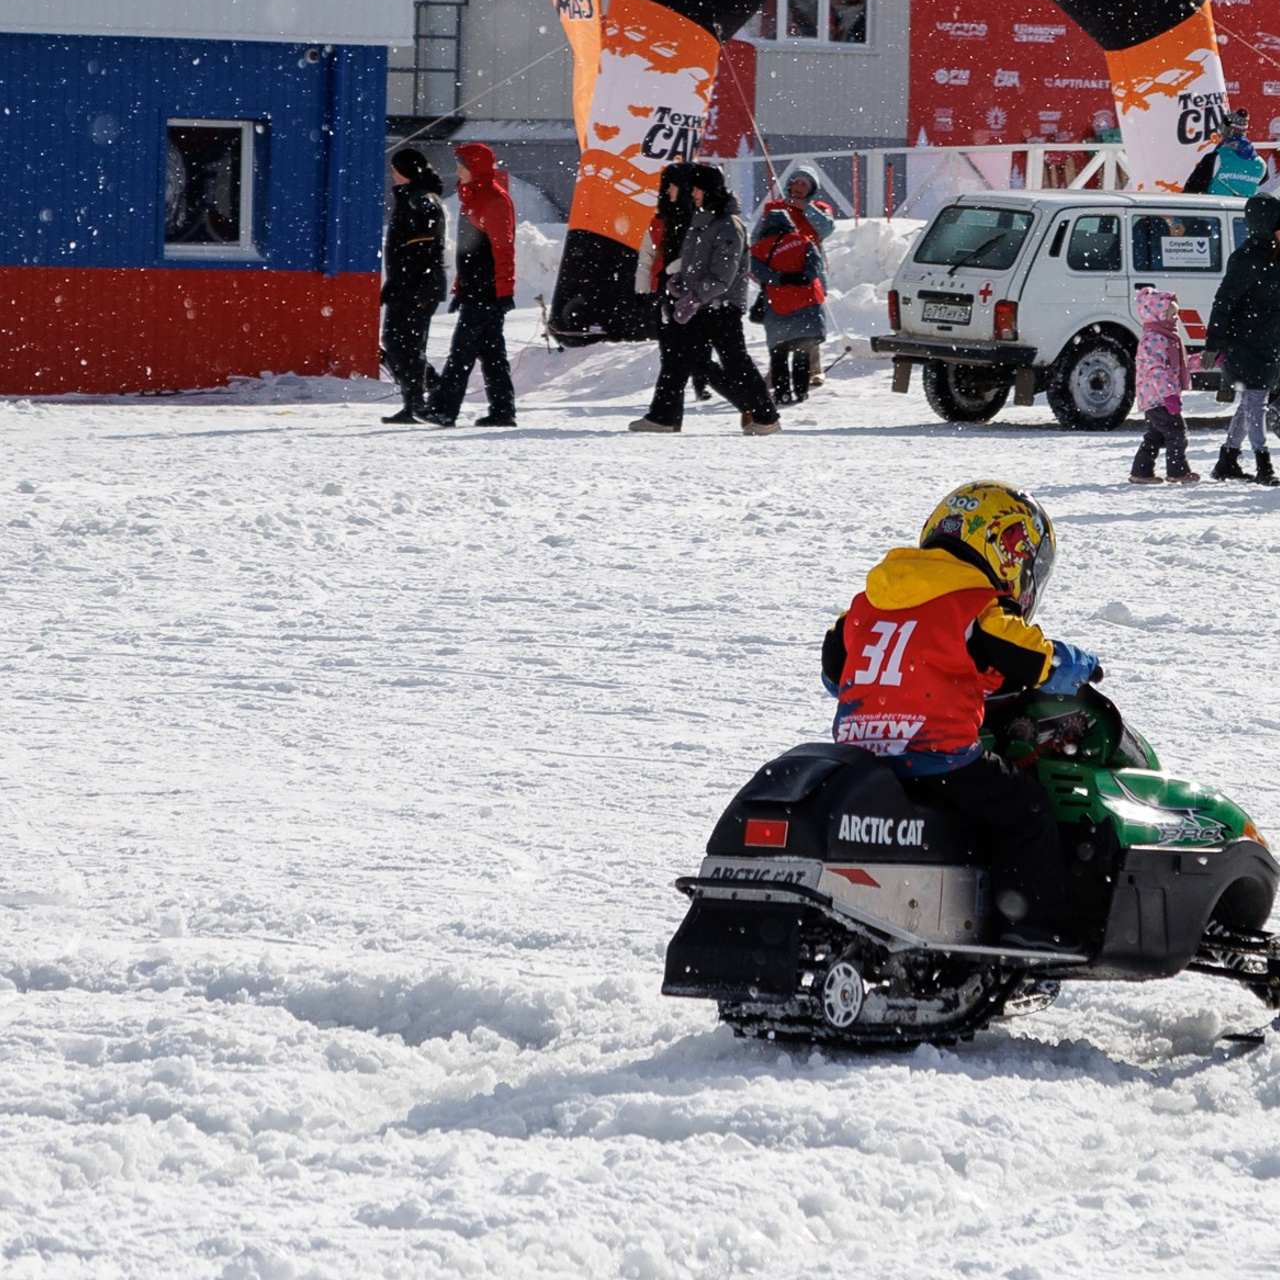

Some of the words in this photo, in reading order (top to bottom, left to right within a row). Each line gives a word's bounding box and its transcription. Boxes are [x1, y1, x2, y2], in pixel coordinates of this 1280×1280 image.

[854, 620, 918, 687] 31
[882, 713, 927, 722] ФЕСТИВАЛЬ
[837, 721, 924, 742] SNOW
[838, 814, 894, 844] ARCTIC
[897, 819, 925, 846] CAT
